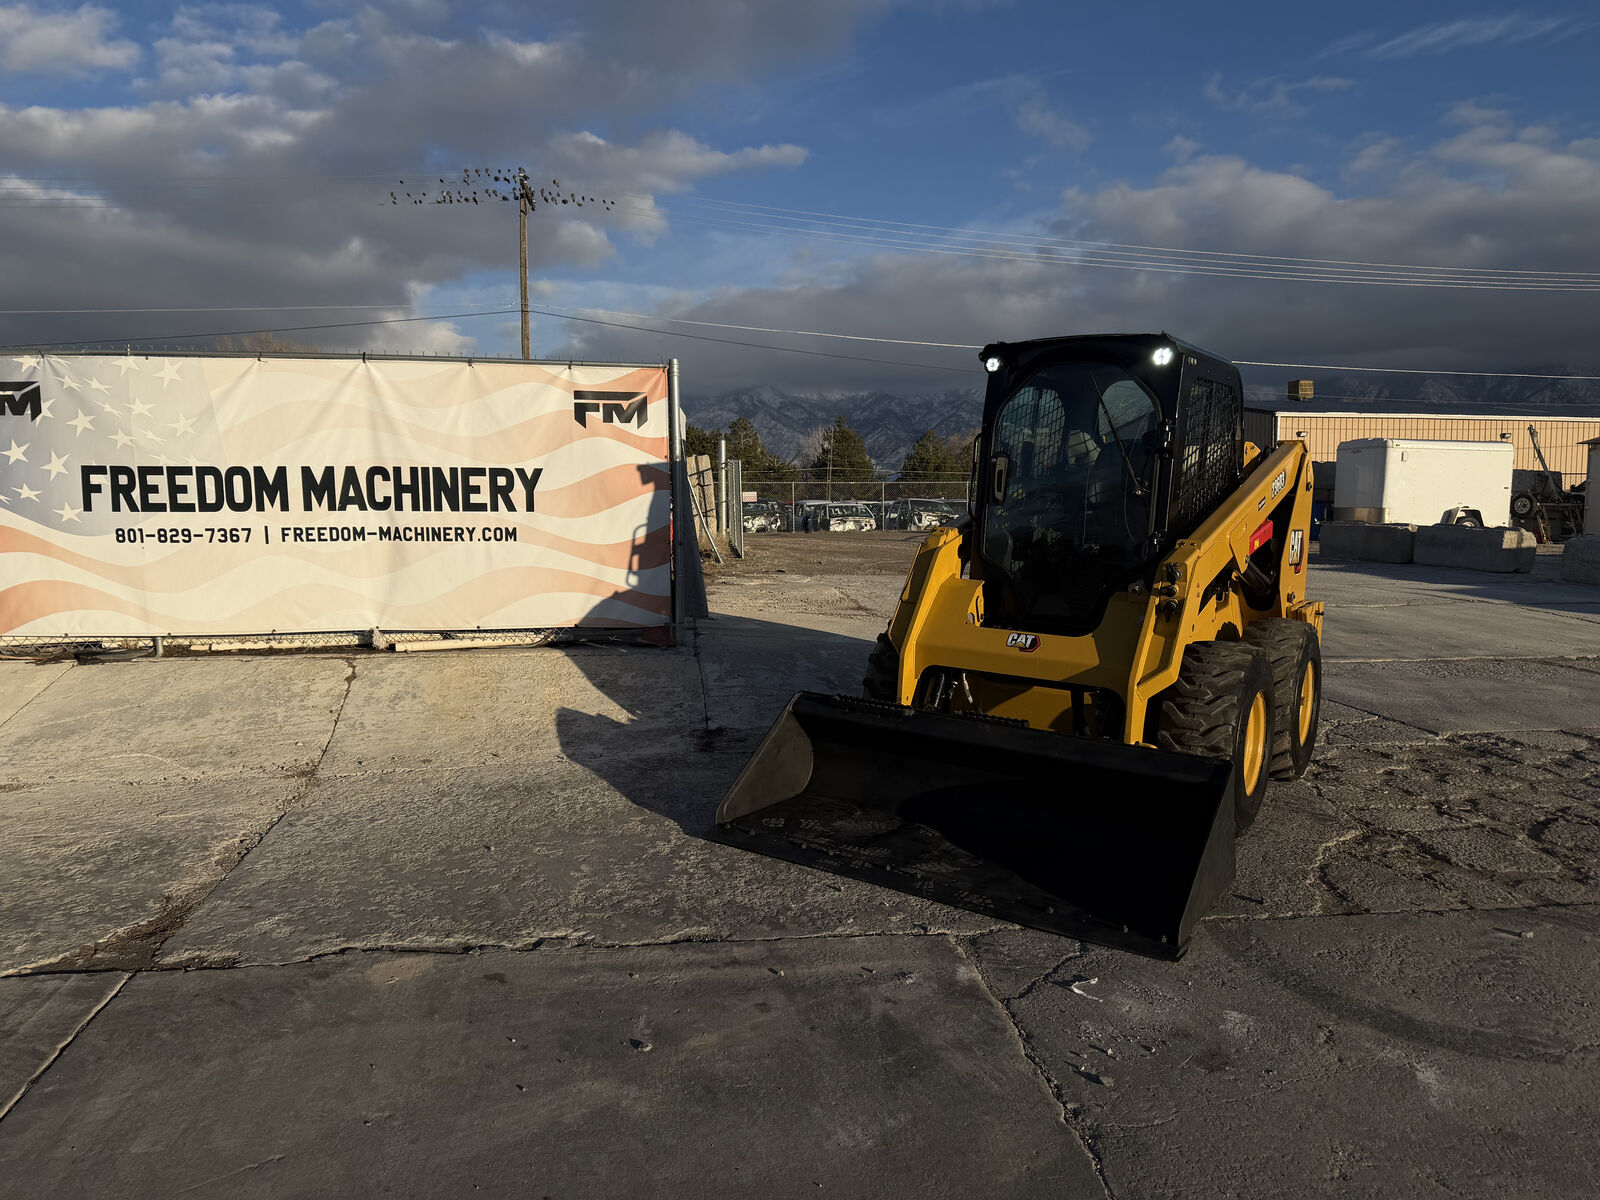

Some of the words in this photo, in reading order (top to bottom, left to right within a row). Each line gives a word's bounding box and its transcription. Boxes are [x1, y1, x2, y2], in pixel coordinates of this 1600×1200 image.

[574, 390, 648, 429] FM
[80, 465, 290, 513] FREEDOM
[300, 465, 543, 513] MACHINERY
[115, 527, 252, 544] 801-829-7367
[281, 526, 518, 542] FREEDOM-MACHINERY.COM
[1289, 530, 1304, 565] CAT
[1006, 633, 1036, 648] CAT
